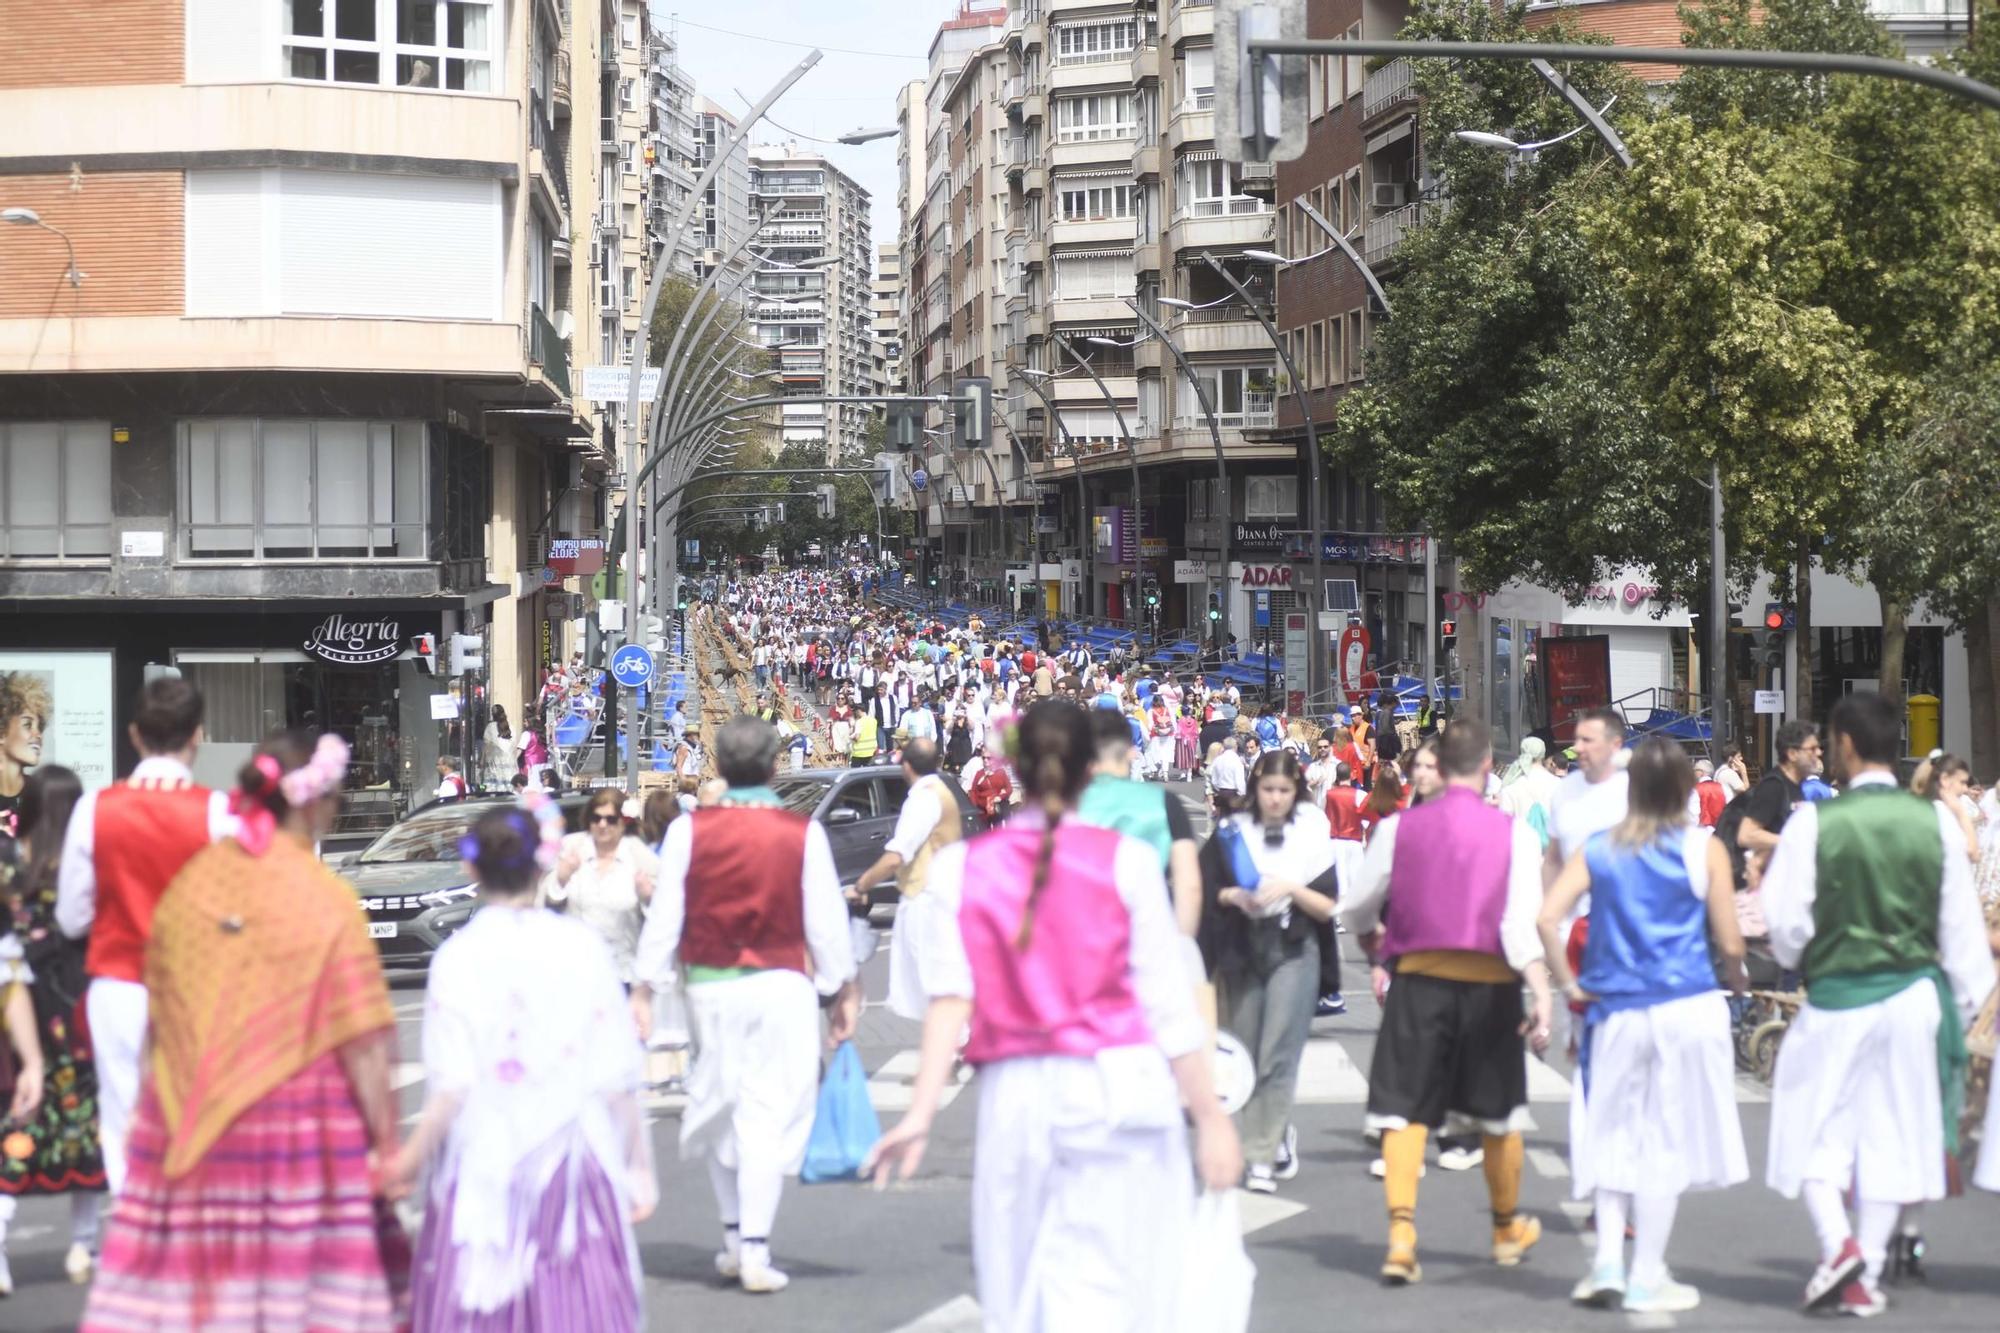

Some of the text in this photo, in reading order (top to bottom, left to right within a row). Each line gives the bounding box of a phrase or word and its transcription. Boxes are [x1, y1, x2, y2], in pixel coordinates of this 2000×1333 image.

[1325, 546, 1348, 554] MGS
[1176, 568, 1205, 576] ADARA
[303, 614, 400, 650] Alegría
